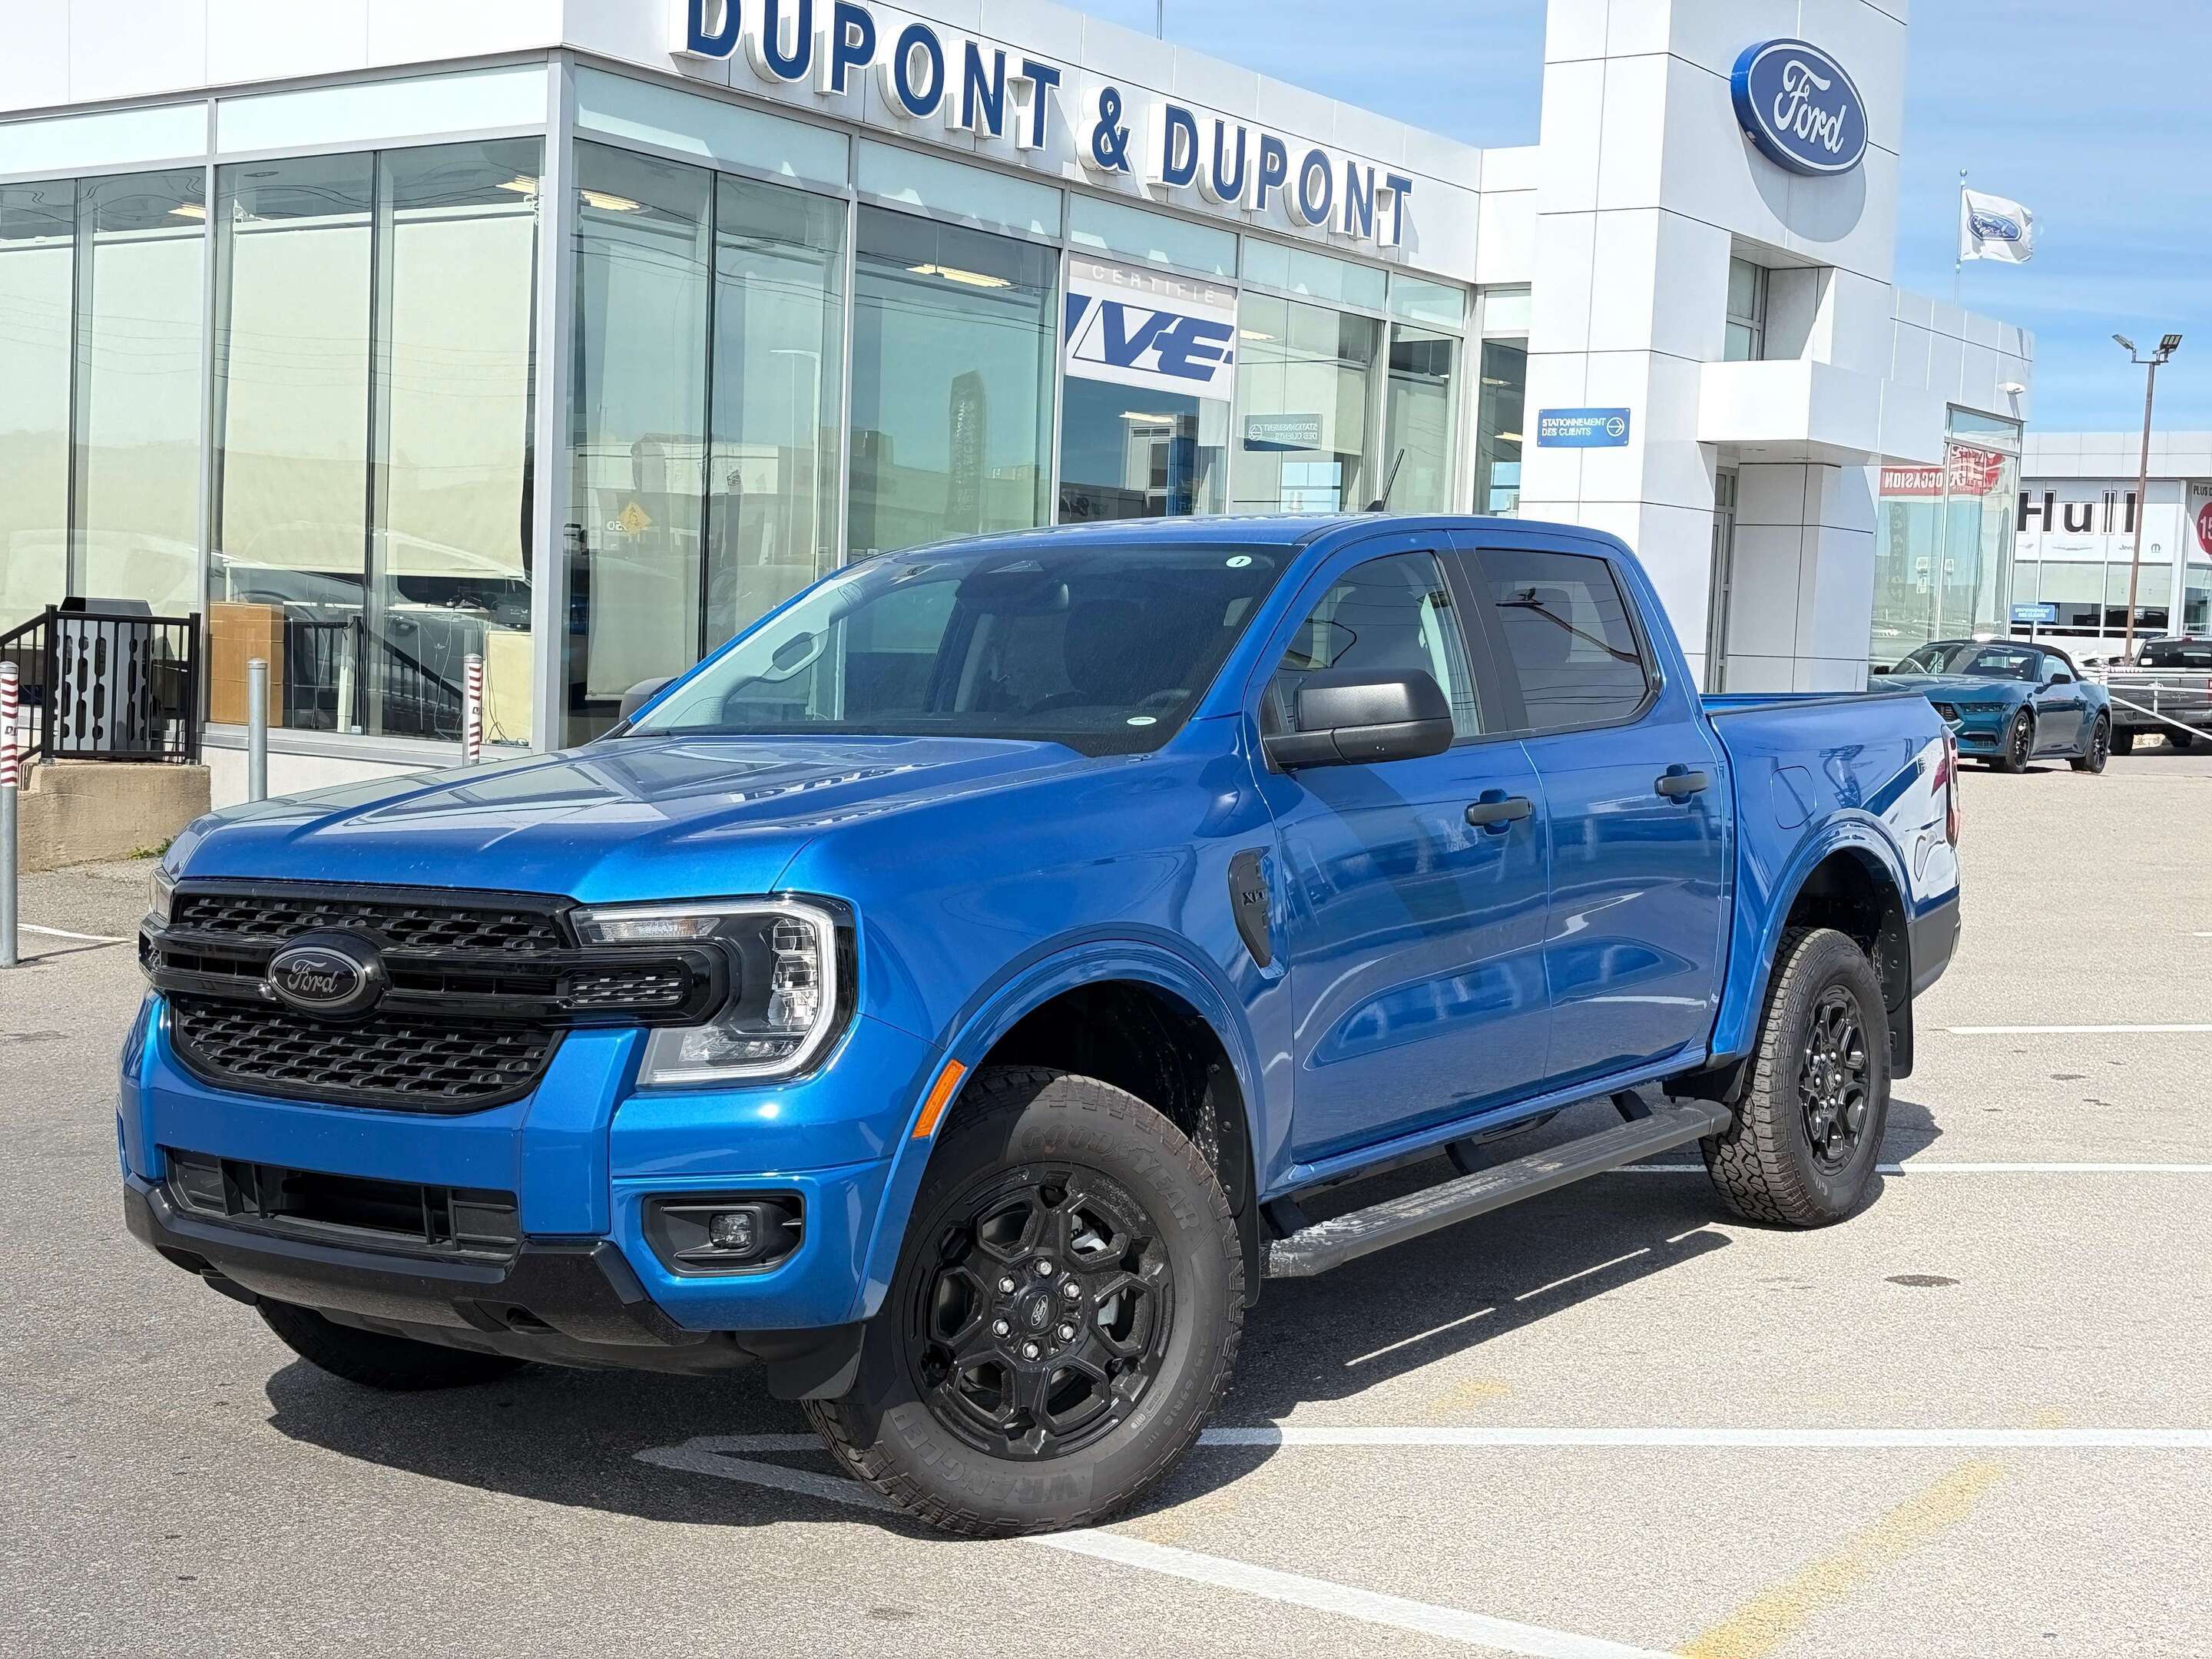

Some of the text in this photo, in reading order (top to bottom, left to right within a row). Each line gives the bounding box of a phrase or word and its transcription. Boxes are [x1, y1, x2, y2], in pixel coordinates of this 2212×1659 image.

[685, 0, 1413, 247] DUPONT & DUPONT
[1773, 60, 1847, 154] Ford
[1091, 264, 1217, 304] CERTIFIÉ
[1541, 417, 1607, 427] STATIONNEMENT
[1541, 427, 1592, 436] DES CLIENTS
[2017, 492, 2135, 532] Hull
[287, 959, 339, 993] Ford
